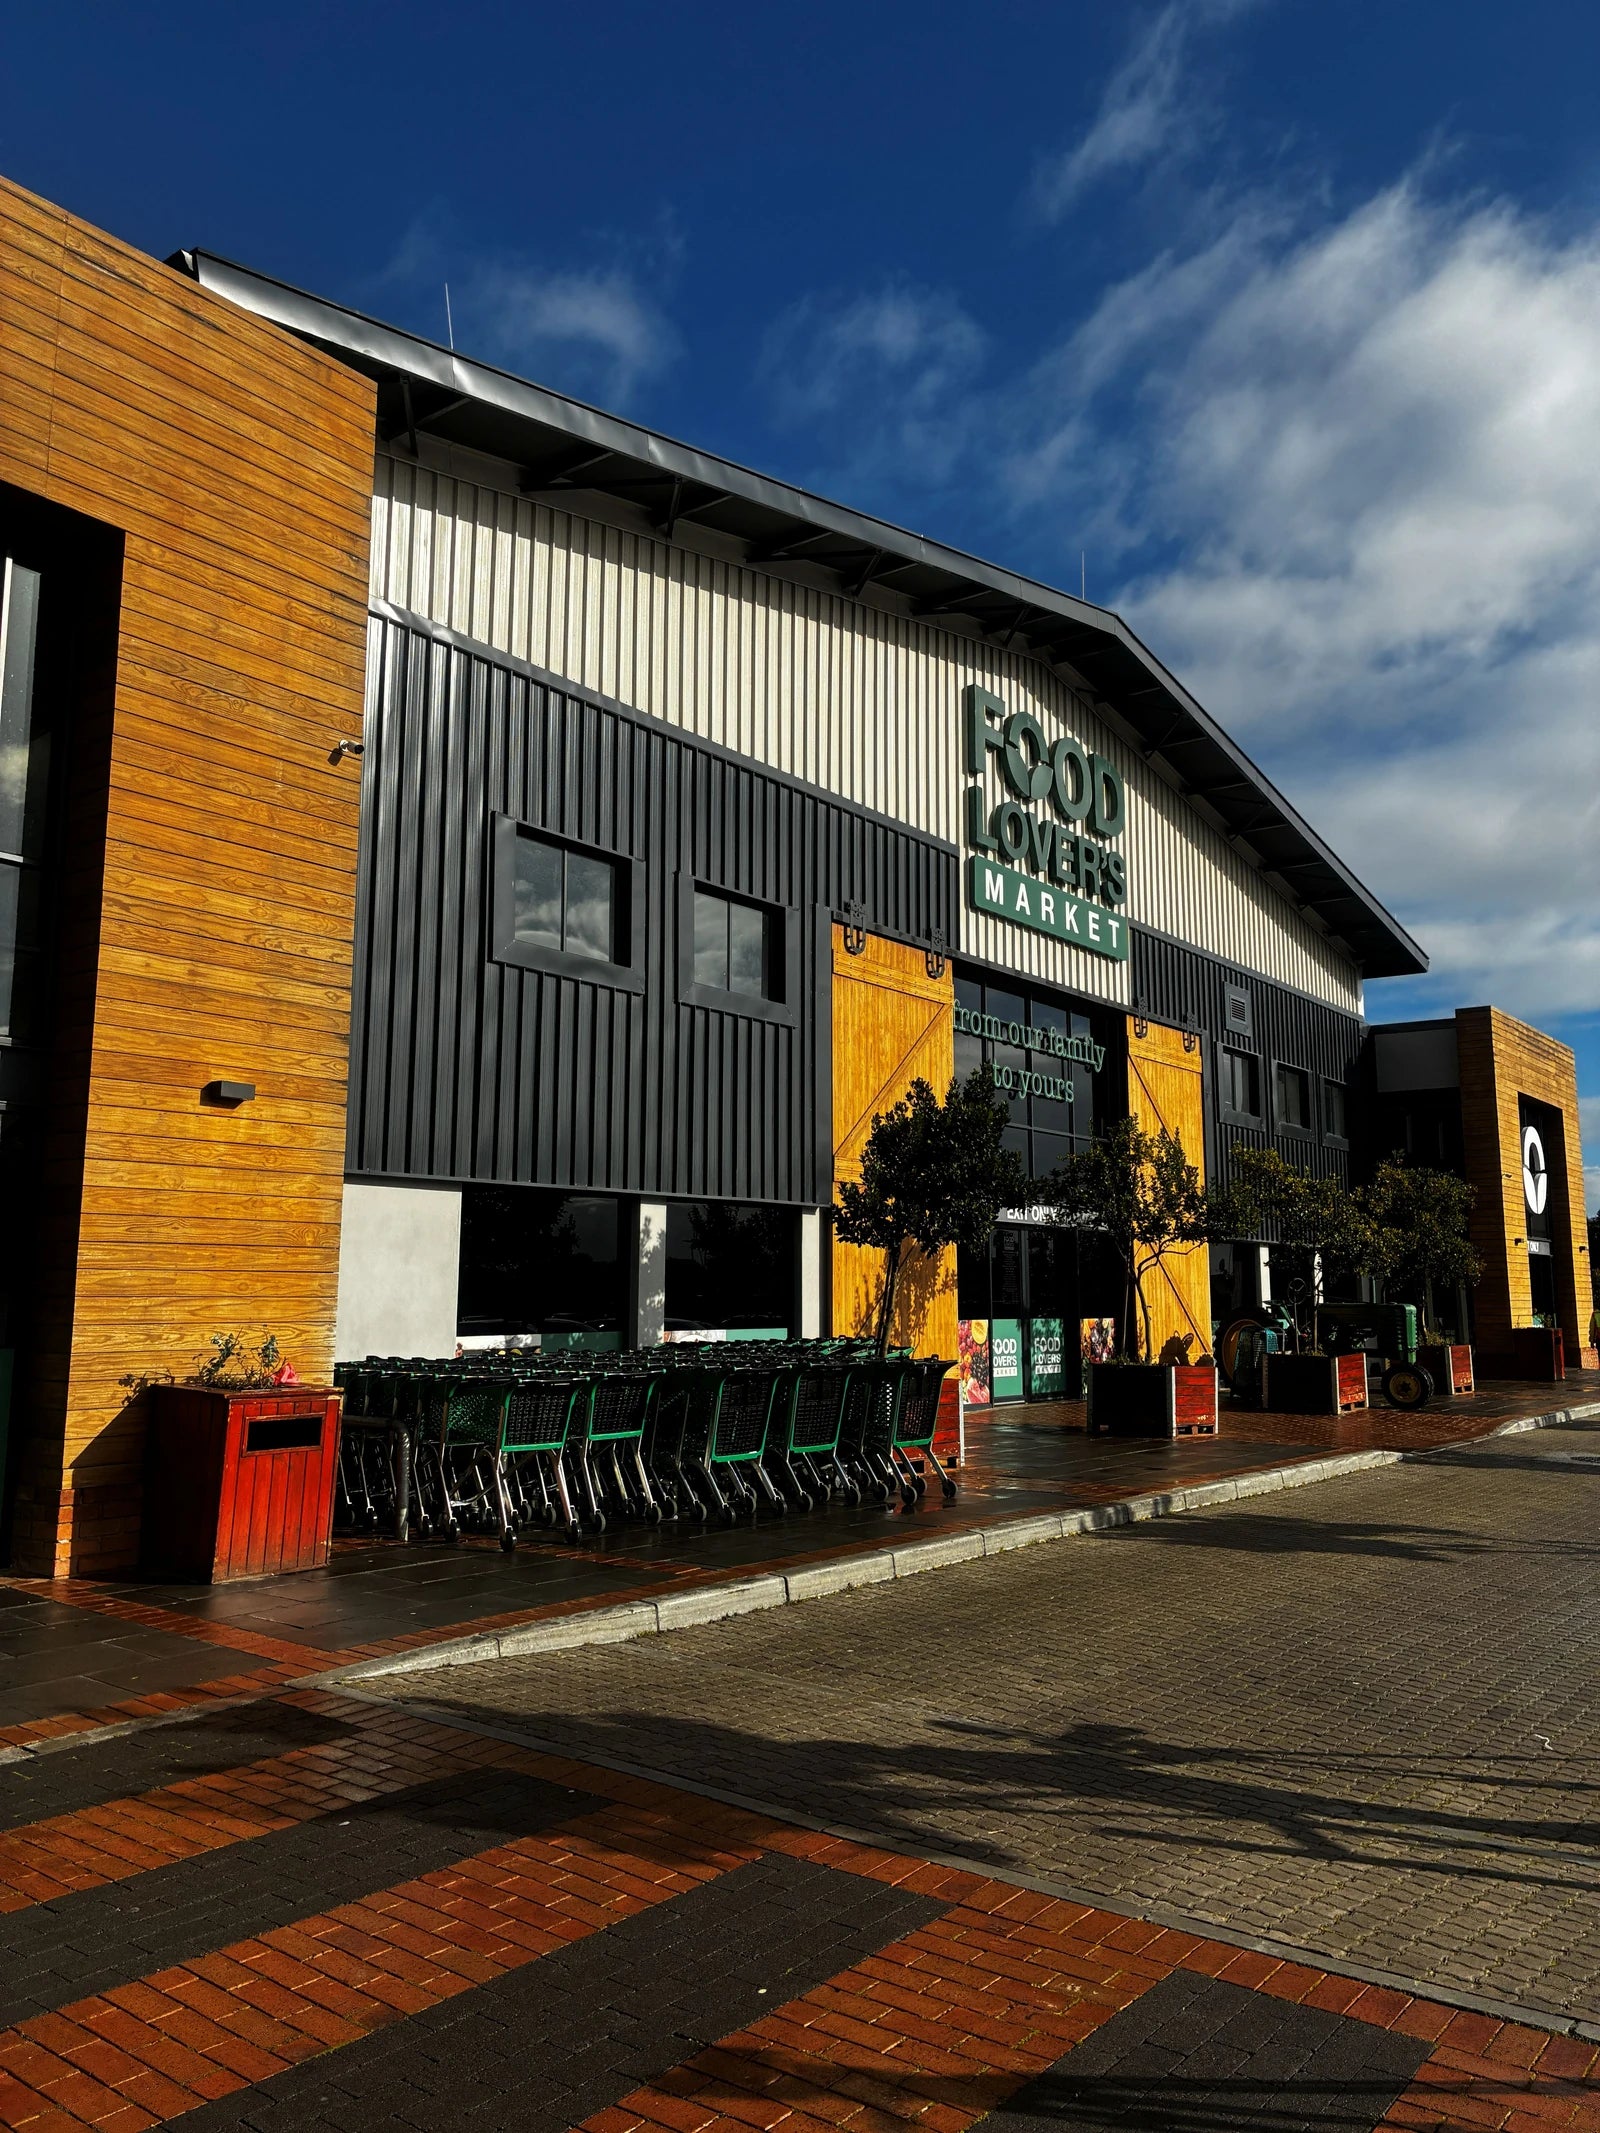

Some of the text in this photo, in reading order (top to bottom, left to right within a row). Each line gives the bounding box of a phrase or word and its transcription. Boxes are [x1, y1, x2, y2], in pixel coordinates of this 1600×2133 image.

[964, 684, 1125, 838] FOOD
[967, 786, 1126, 905] LOVER'S
[984, 868, 1120, 949] MARKET
[953, 999, 1106, 1073] from our family
[992, 1059, 1074, 1103] to yours
[993, 1355, 1018, 1367] OVER'S
[1034, 1336, 1061, 1353] FOOD
